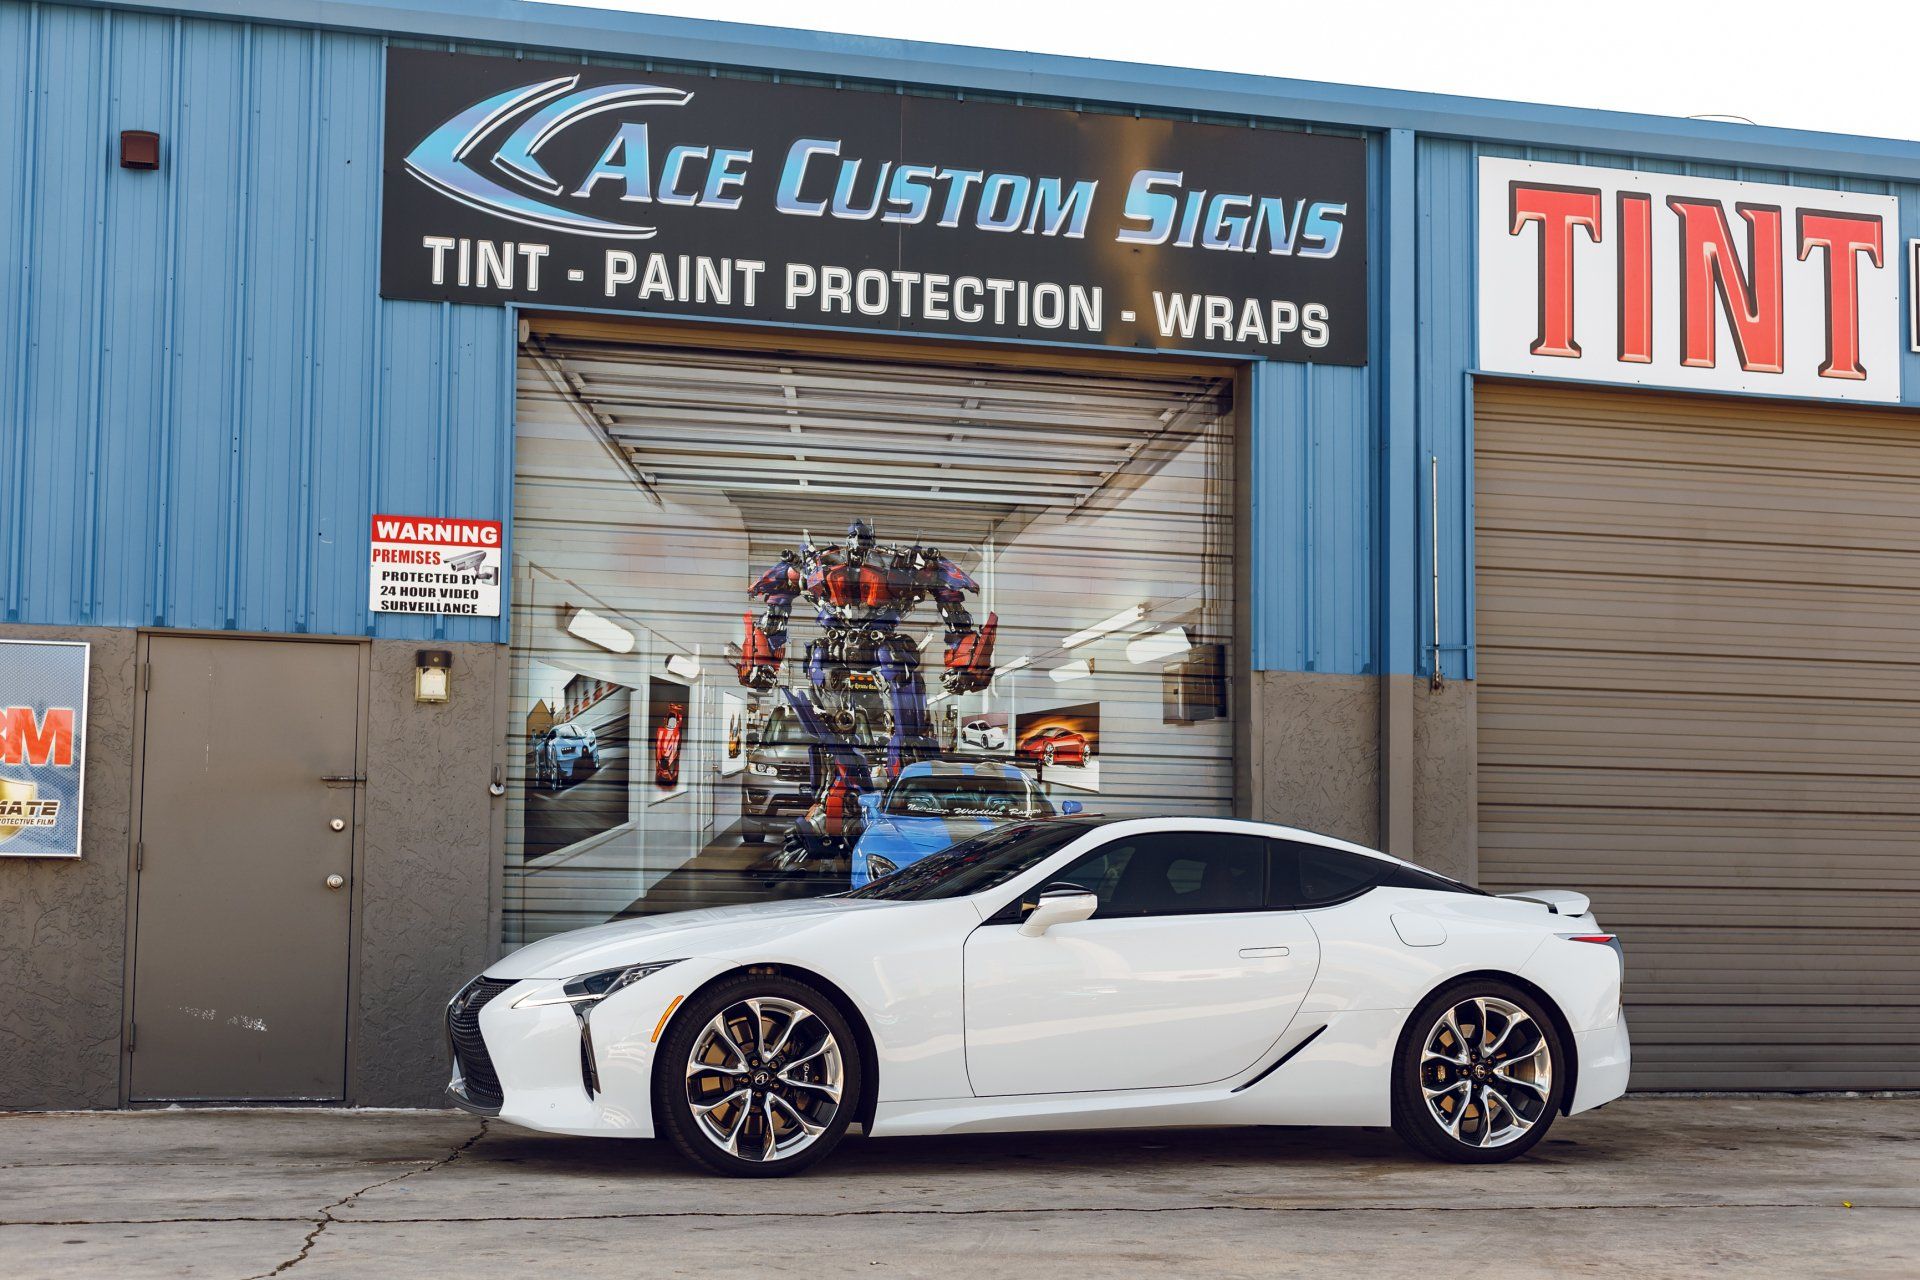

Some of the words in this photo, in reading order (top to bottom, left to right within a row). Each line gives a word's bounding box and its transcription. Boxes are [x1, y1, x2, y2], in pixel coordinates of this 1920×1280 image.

[570, 122, 753, 210] ACE
[775, 138, 1098, 240] CUSTOM
[1115, 169, 1347, 259] SIGNS
[422, 235, 550, 291] TINT
[604, 249, 766, 307] PAINT
[785, 262, 1102, 332] PROTECTION
[1152, 290, 1330, 348] WRAPS
[1508, 180, 1884, 381] TINT
[376, 521, 498, 544] WARNING
[372, 548, 441, 565] PREMISES
[382, 571, 458, 585] PROTECTED
[461, 574, 478, 585] BY
[380, 585, 397, 596] 24
[399, 586, 436, 598] HOUR
[439, 588, 479, 600] VIDEO
[381, 600, 478, 614] SURVEILLANCE
[0, 707, 74, 766] M
